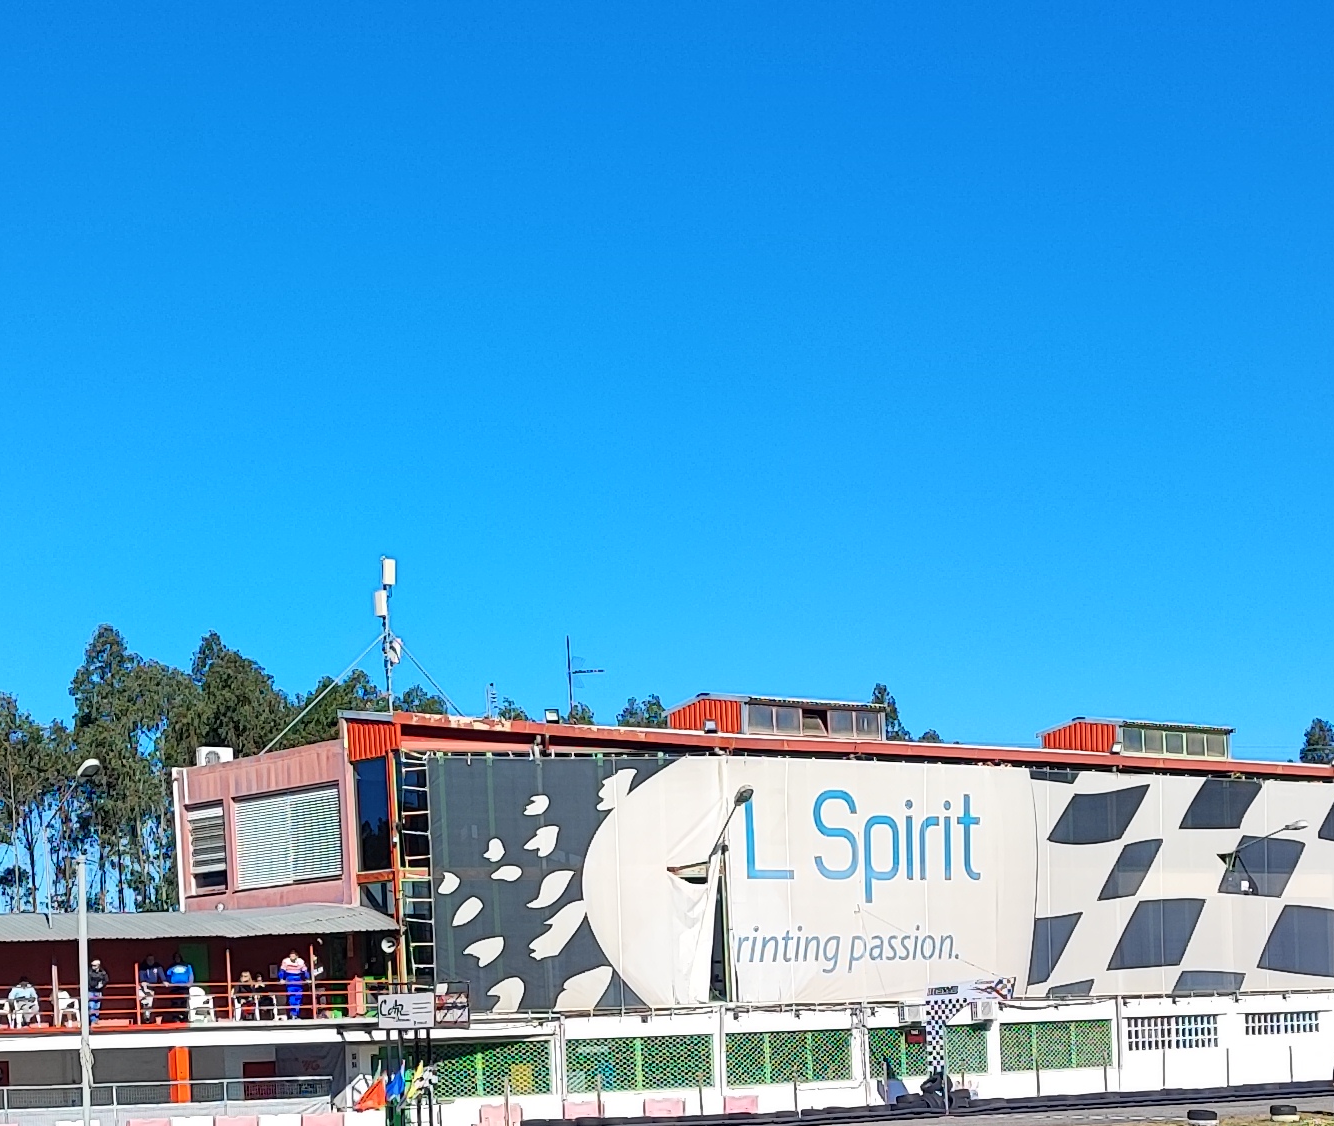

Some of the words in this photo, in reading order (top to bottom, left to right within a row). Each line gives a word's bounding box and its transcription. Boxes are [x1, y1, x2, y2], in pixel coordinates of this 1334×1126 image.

[813, 789, 981, 904] Spirit
[736, 925, 841, 974] rinting
[848, 924, 960, 974] passion.
